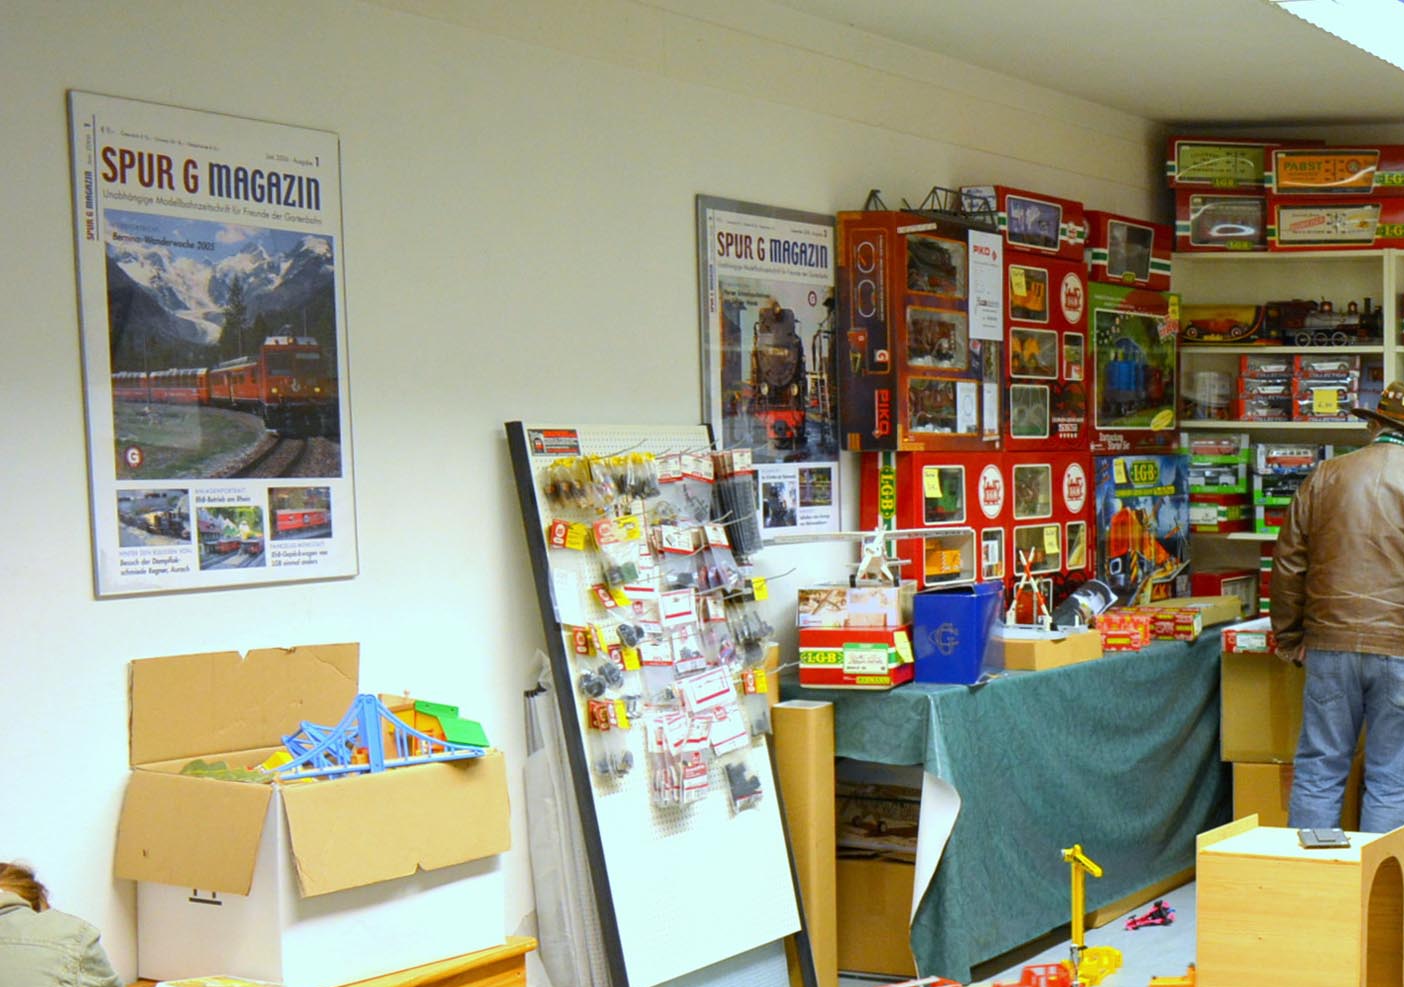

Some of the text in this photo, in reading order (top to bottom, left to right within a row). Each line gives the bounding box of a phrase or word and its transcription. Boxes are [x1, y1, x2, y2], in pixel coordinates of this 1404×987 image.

[101, 146, 320, 211] SPUR G MAGAZIN
[315, 156, 320, 167] 1
[717, 231, 828, 269] SPUR G MAGAZIN
[877, 389, 891, 436] PIKO
[880, 474, 895, 510] LGB
[807, 651, 838, 664] LGB
